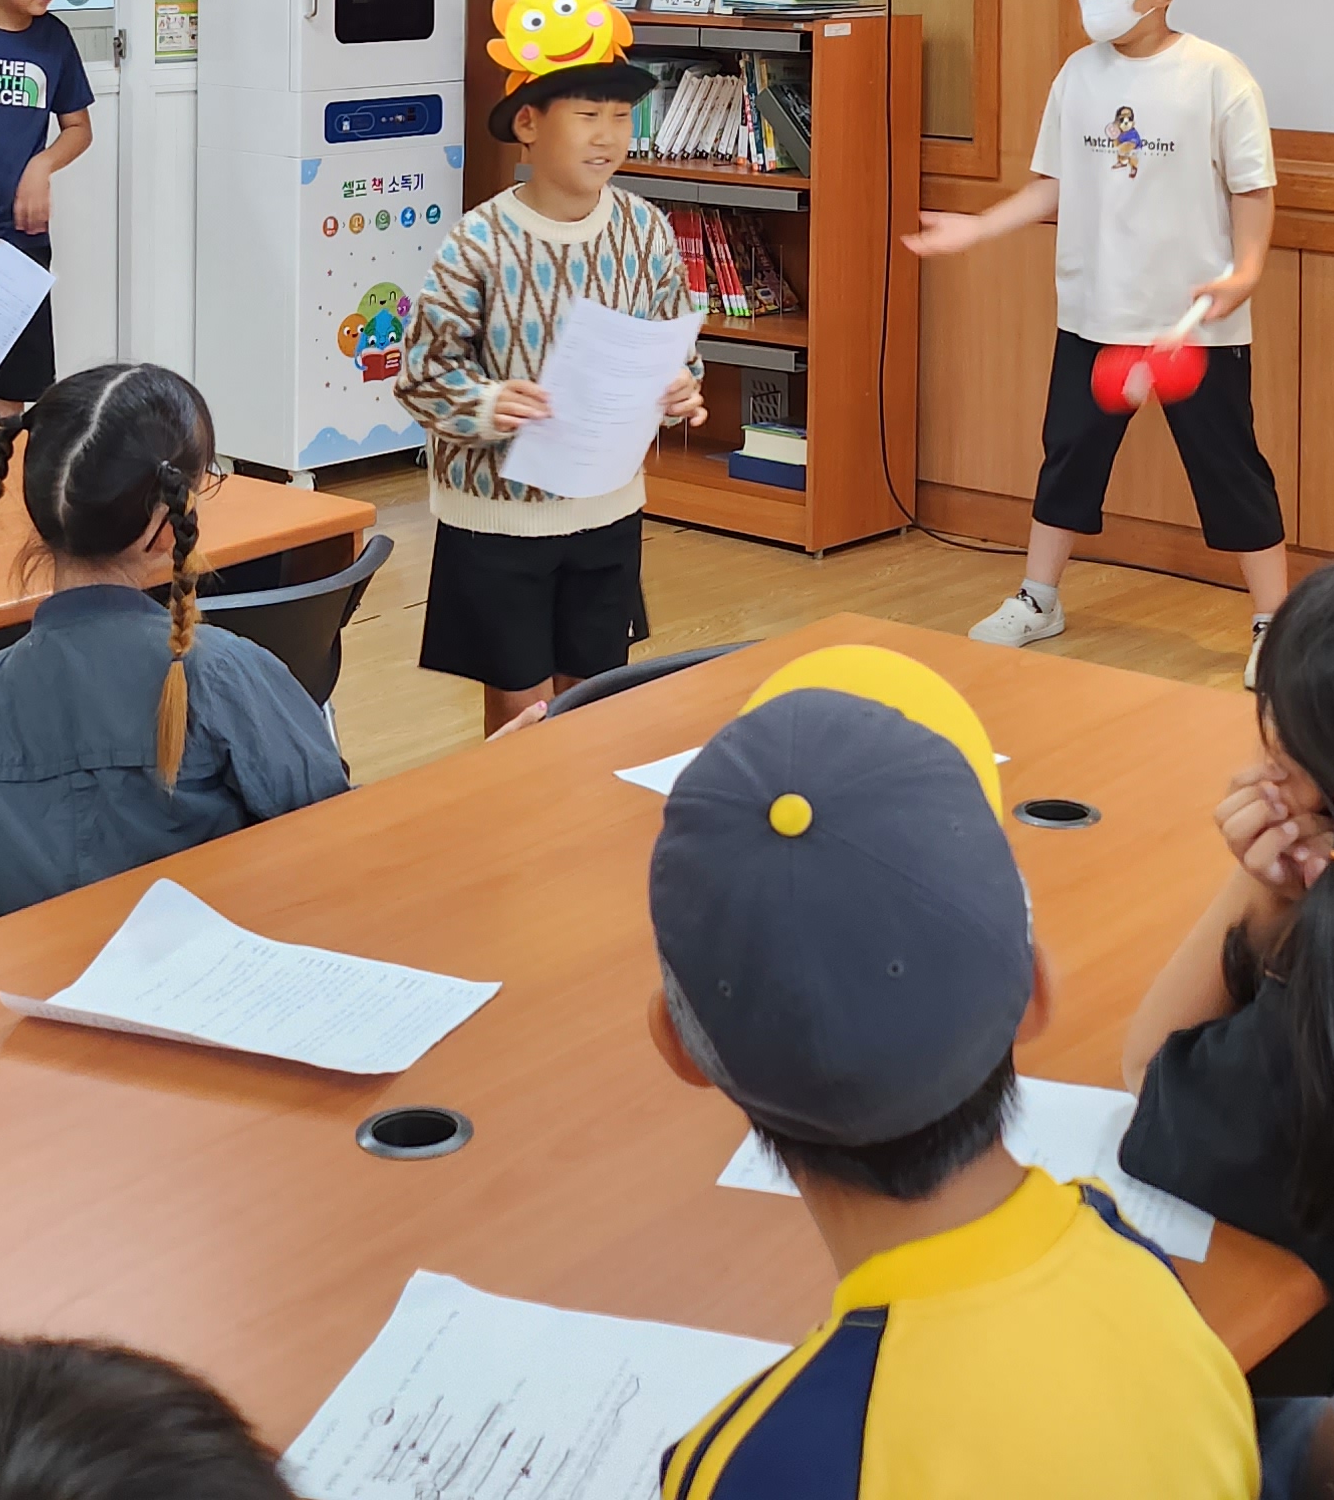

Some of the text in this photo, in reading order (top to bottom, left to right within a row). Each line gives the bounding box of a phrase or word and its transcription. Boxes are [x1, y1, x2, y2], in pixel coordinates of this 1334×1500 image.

[342, 173, 424, 199] 셀프 책 소독기
